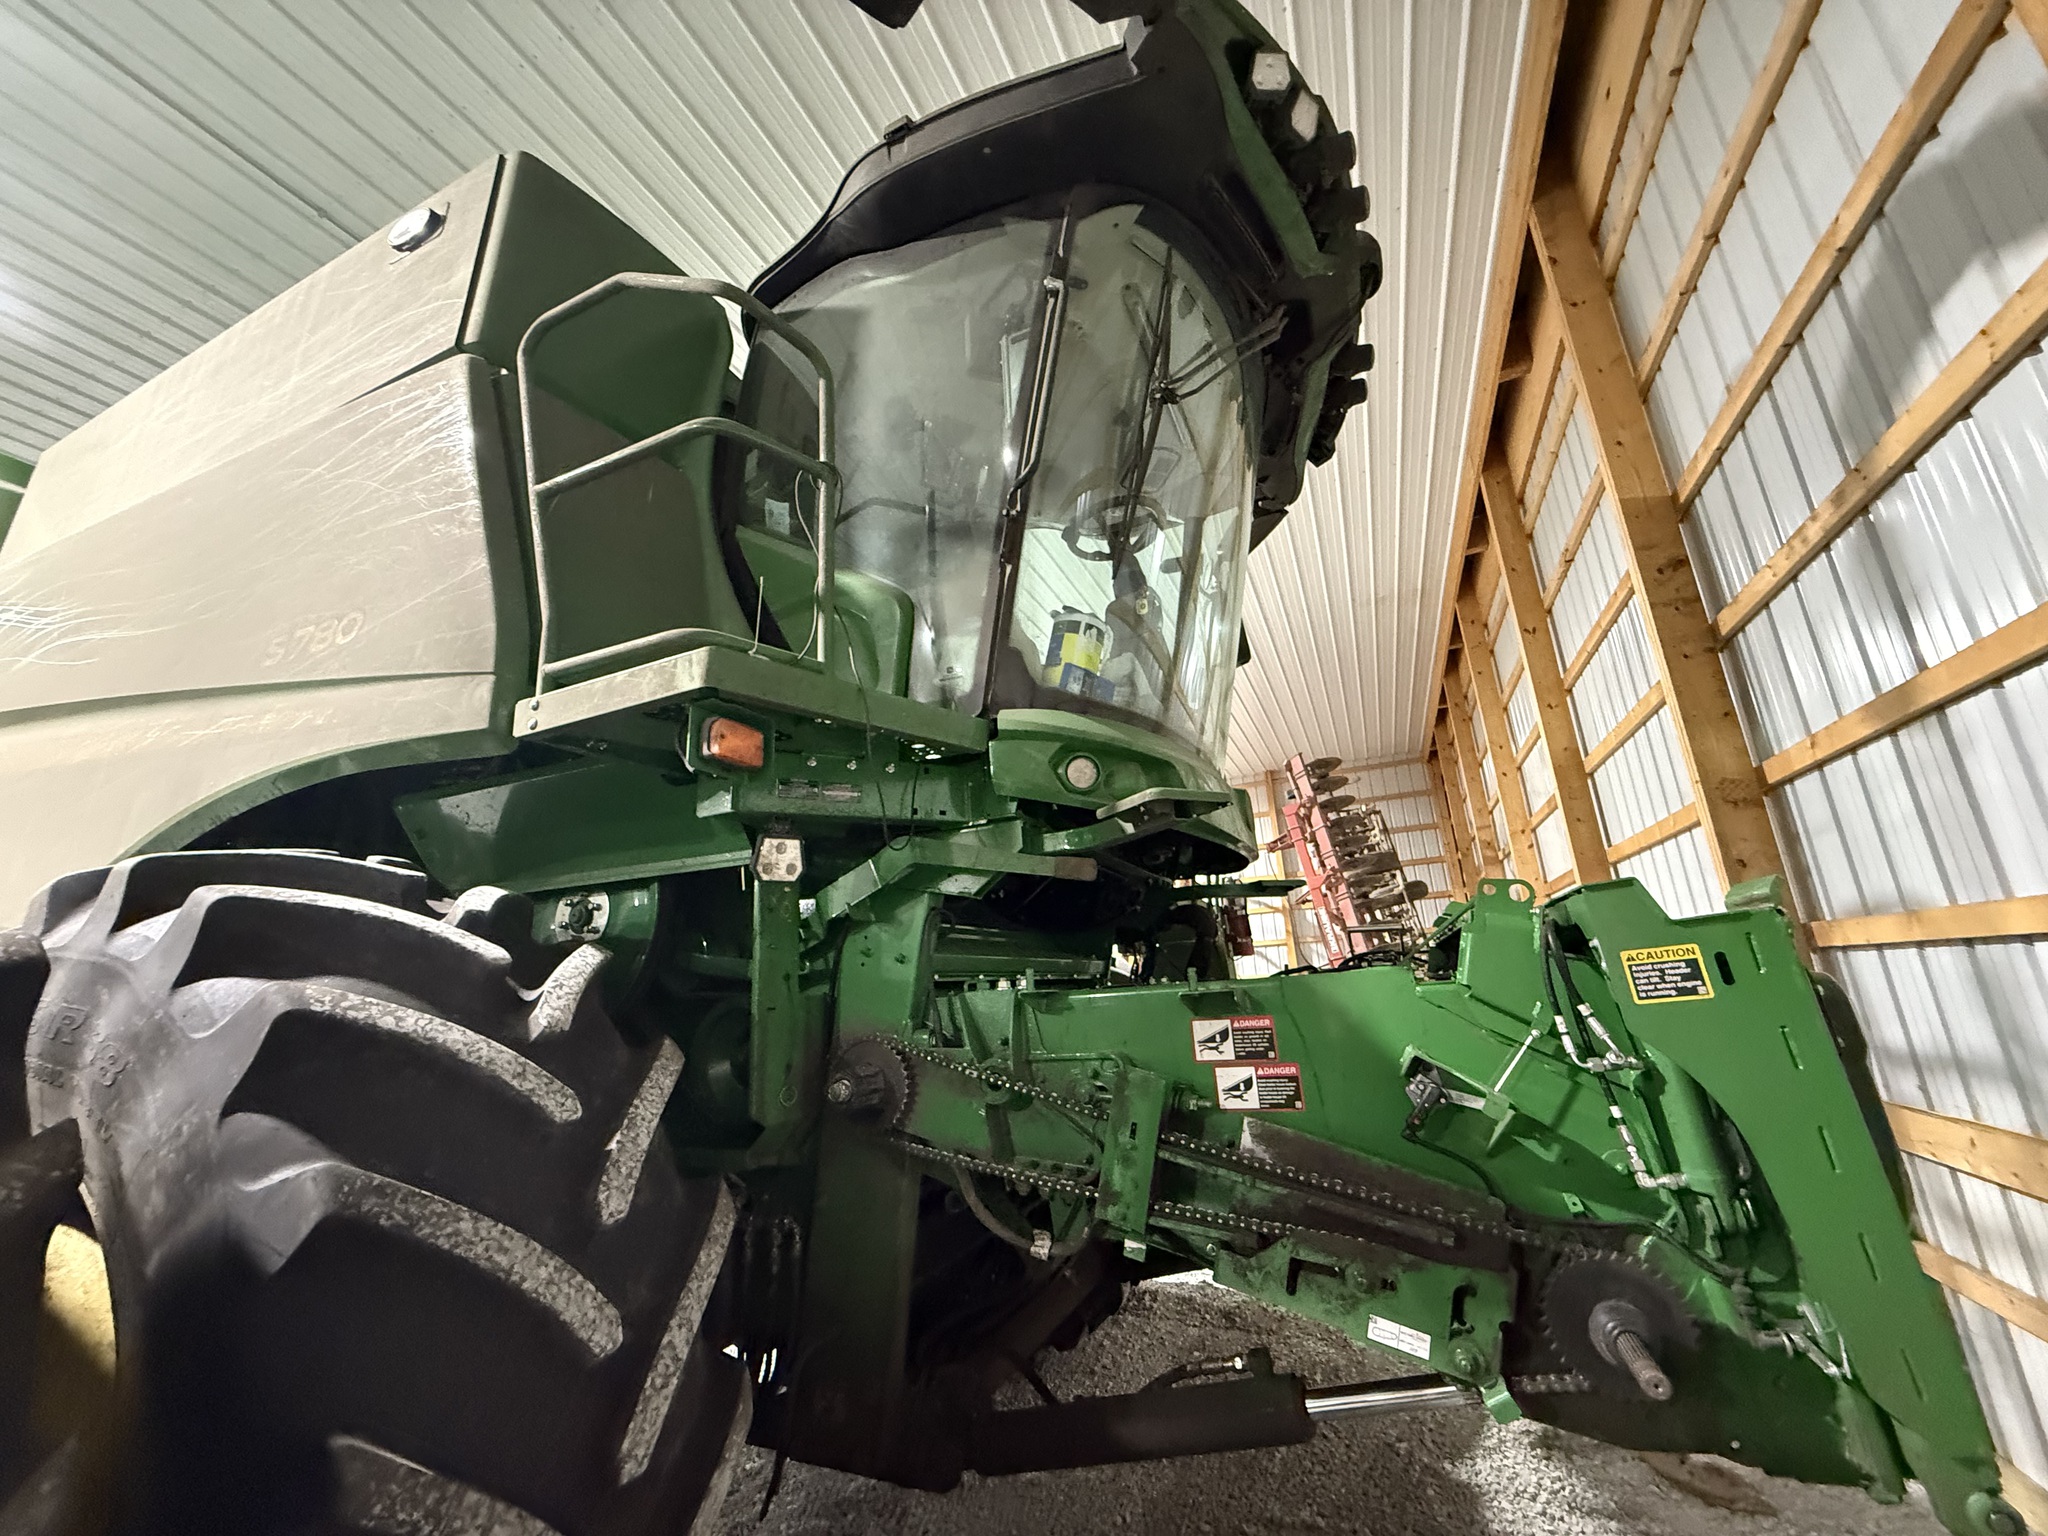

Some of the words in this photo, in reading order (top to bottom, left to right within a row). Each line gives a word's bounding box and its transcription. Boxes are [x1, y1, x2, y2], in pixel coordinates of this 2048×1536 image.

[1635, 947, 1696, 961] CAUTION
[1631, 964, 1653, 972] Avoid
[1653, 961, 1686, 970] crushing
[1239, 1019, 1271, 1027] DANGER
[1263, 1067, 1297, 1075] DANGER
